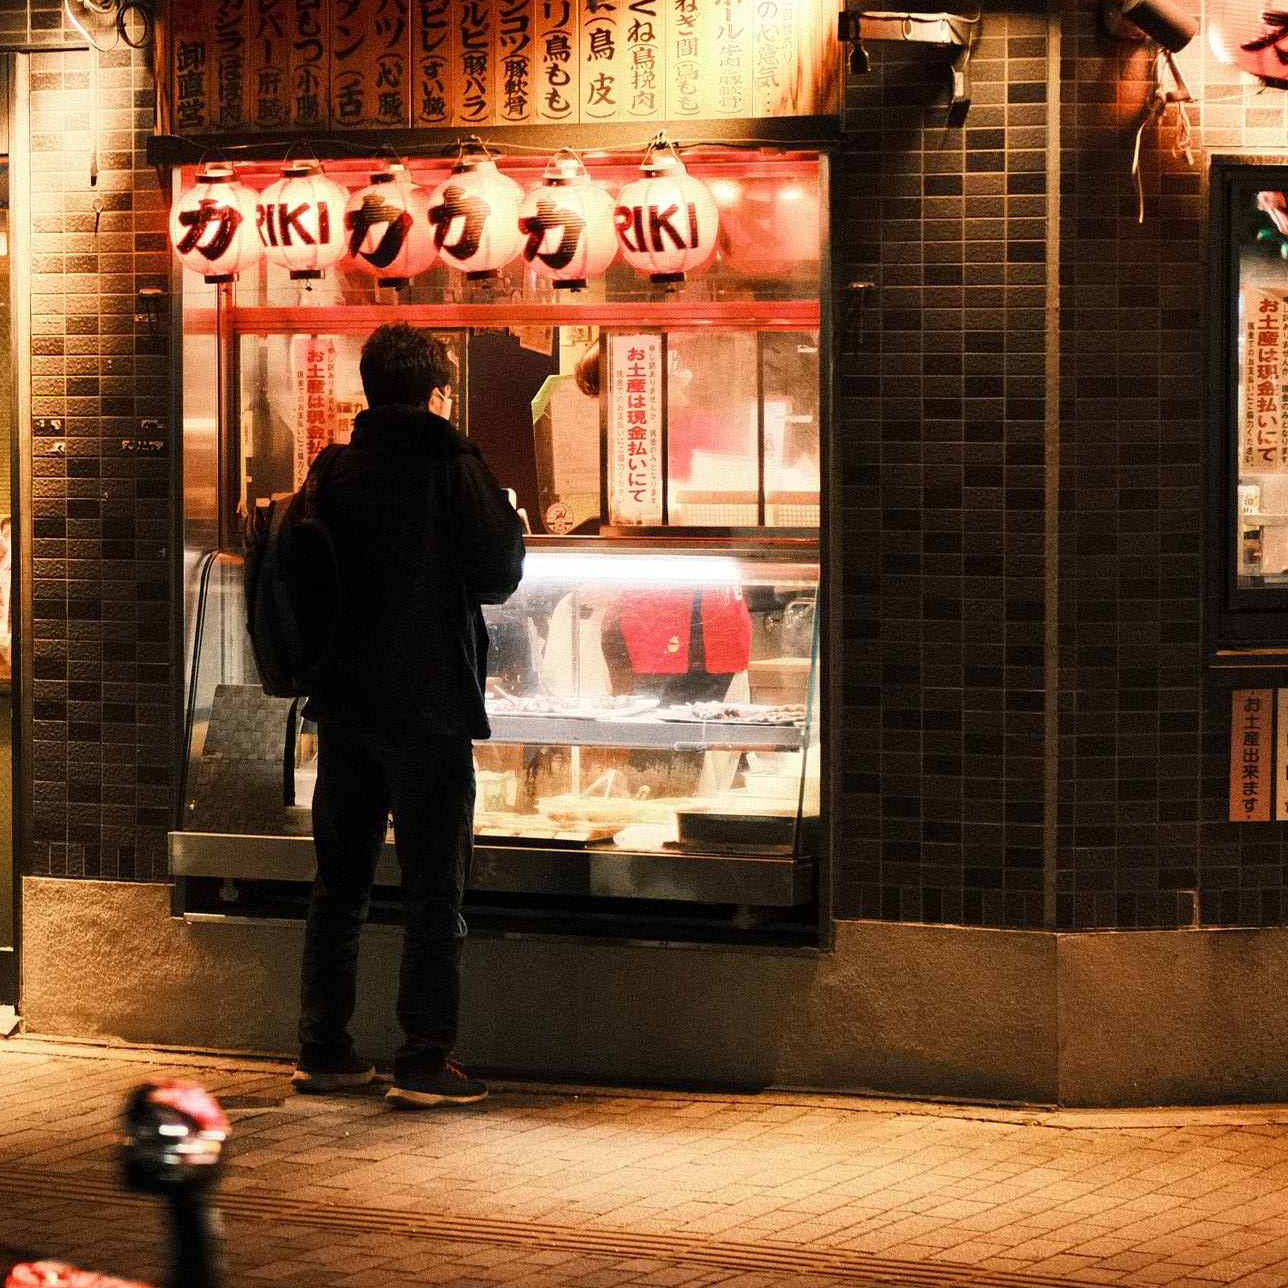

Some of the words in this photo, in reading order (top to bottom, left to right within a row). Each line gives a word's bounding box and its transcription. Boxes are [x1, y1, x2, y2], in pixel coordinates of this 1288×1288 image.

[176, 198, 244, 261] 力
[344, 193, 414, 268] 力
[428, 185, 491, 261] 力
[518, 198, 588, 270] 力
[626, 347, 648, 503] お土産は現金払いにて
